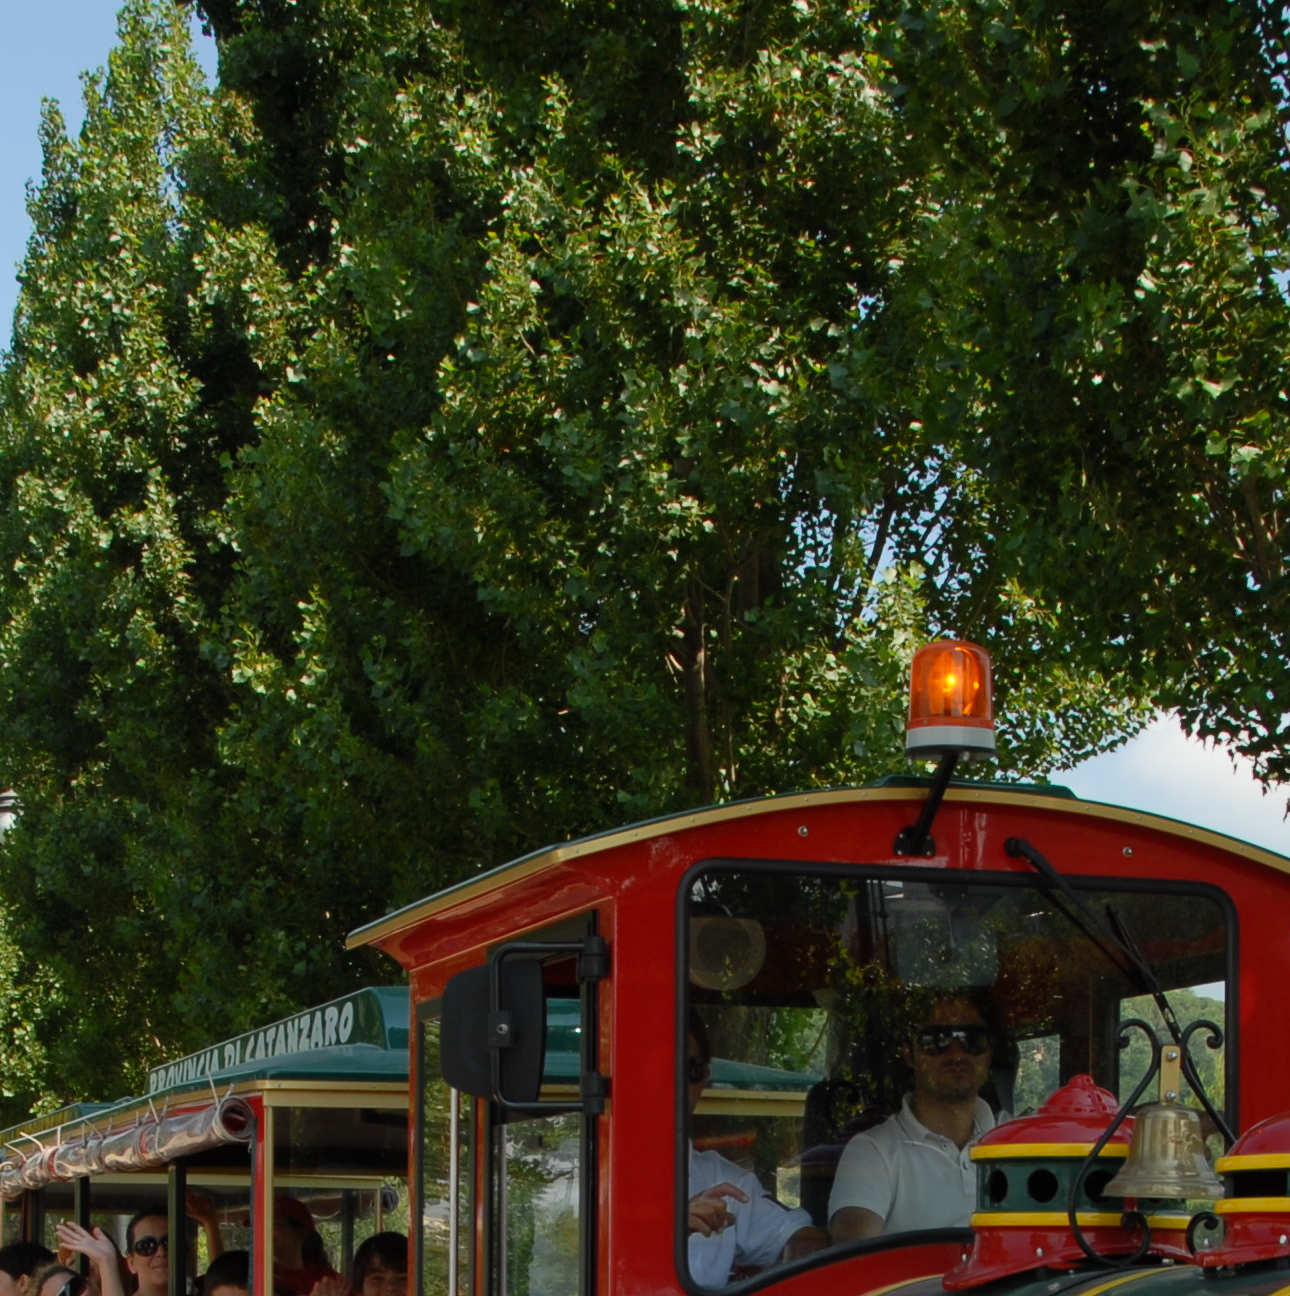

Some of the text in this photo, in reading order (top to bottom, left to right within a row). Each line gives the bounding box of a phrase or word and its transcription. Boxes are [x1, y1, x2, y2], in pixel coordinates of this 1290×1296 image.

[149, 1001, 354, 1096] PROVINCIA DI CATANZARO
